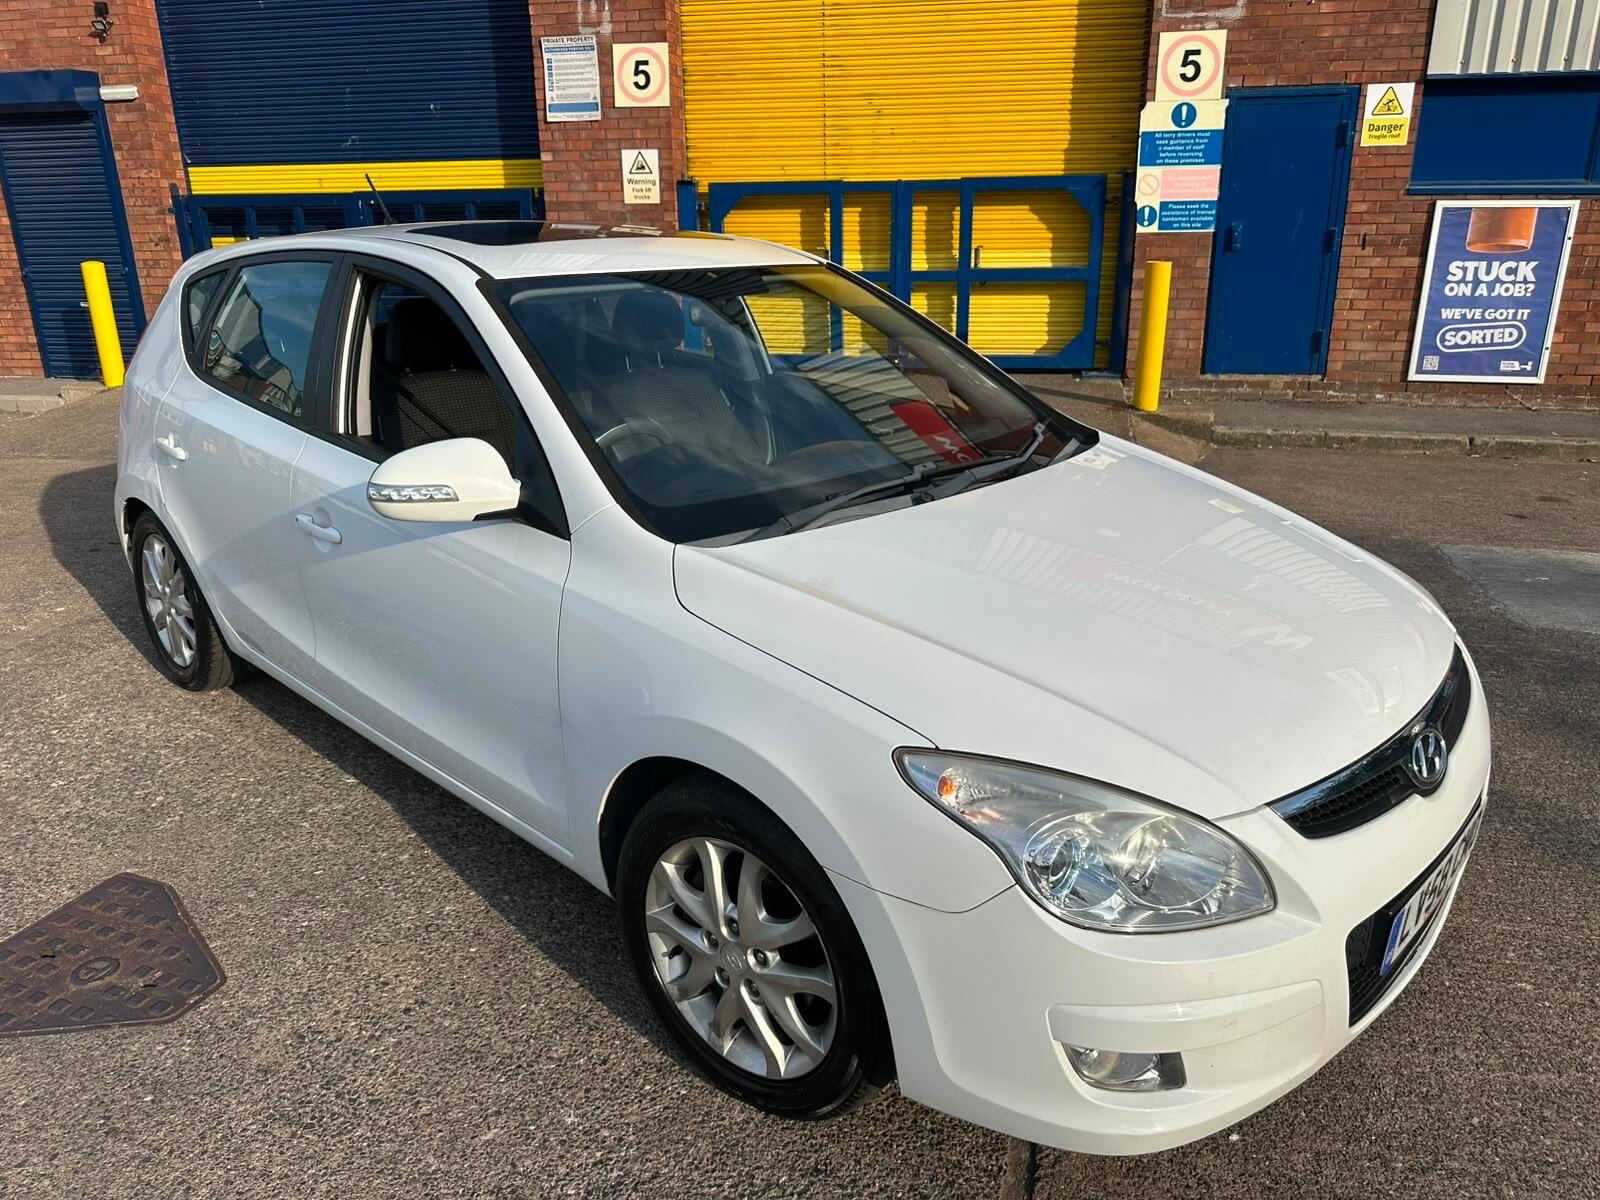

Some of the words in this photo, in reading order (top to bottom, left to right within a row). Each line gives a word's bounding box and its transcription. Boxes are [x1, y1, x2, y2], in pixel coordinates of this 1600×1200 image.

[1179, 49, 1201, 82] 5
[633, 60, 651, 90] 5
[1368, 124, 1404, 133] Danger
[627, 178, 656, 186] Warning
[1446, 261, 1539, 281] STUCK
[1444, 283, 1472, 296] ON
[1474, 283, 1488, 296] A
[1491, 283, 1535, 296] JOB?
[1441, 308, 1483, 320] WE'VE
[1484, 308, 1515, 320] GOT
[1516, 308, 1531, 320] IT
[1444, 327, 1518, 346] SORTED
